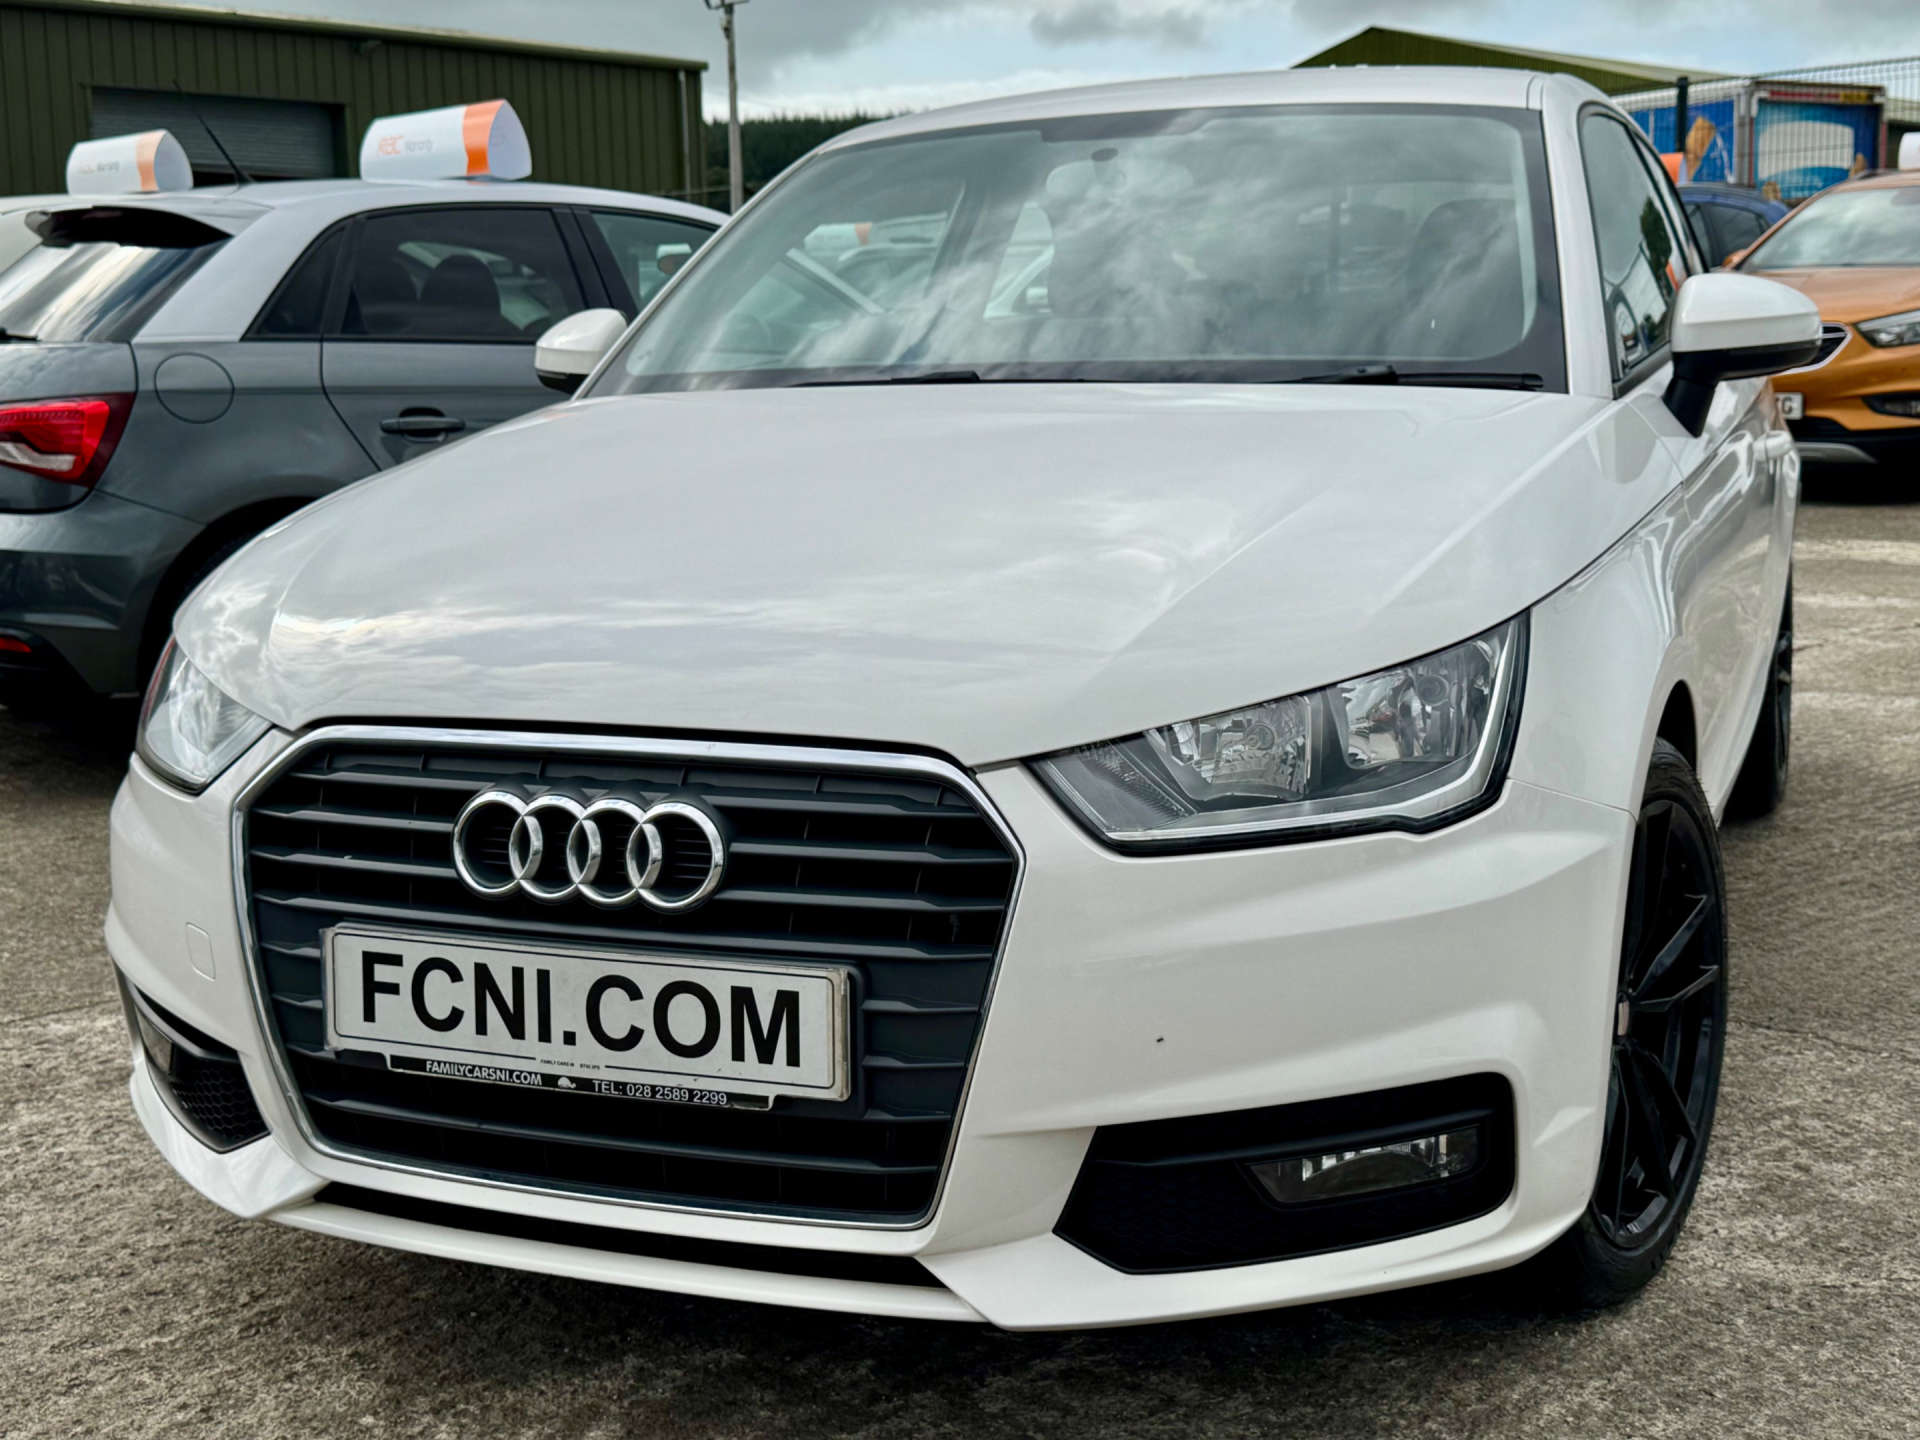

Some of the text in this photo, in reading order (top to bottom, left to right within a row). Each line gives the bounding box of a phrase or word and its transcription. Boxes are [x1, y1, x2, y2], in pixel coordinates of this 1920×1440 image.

[361, 951, 801, 1068] FCNI.COM
[426, 1061, 542, 1086] FAMILYCARSNI.COM
[592, 1080, 728, 1105] TEL: 028 2589 2299
